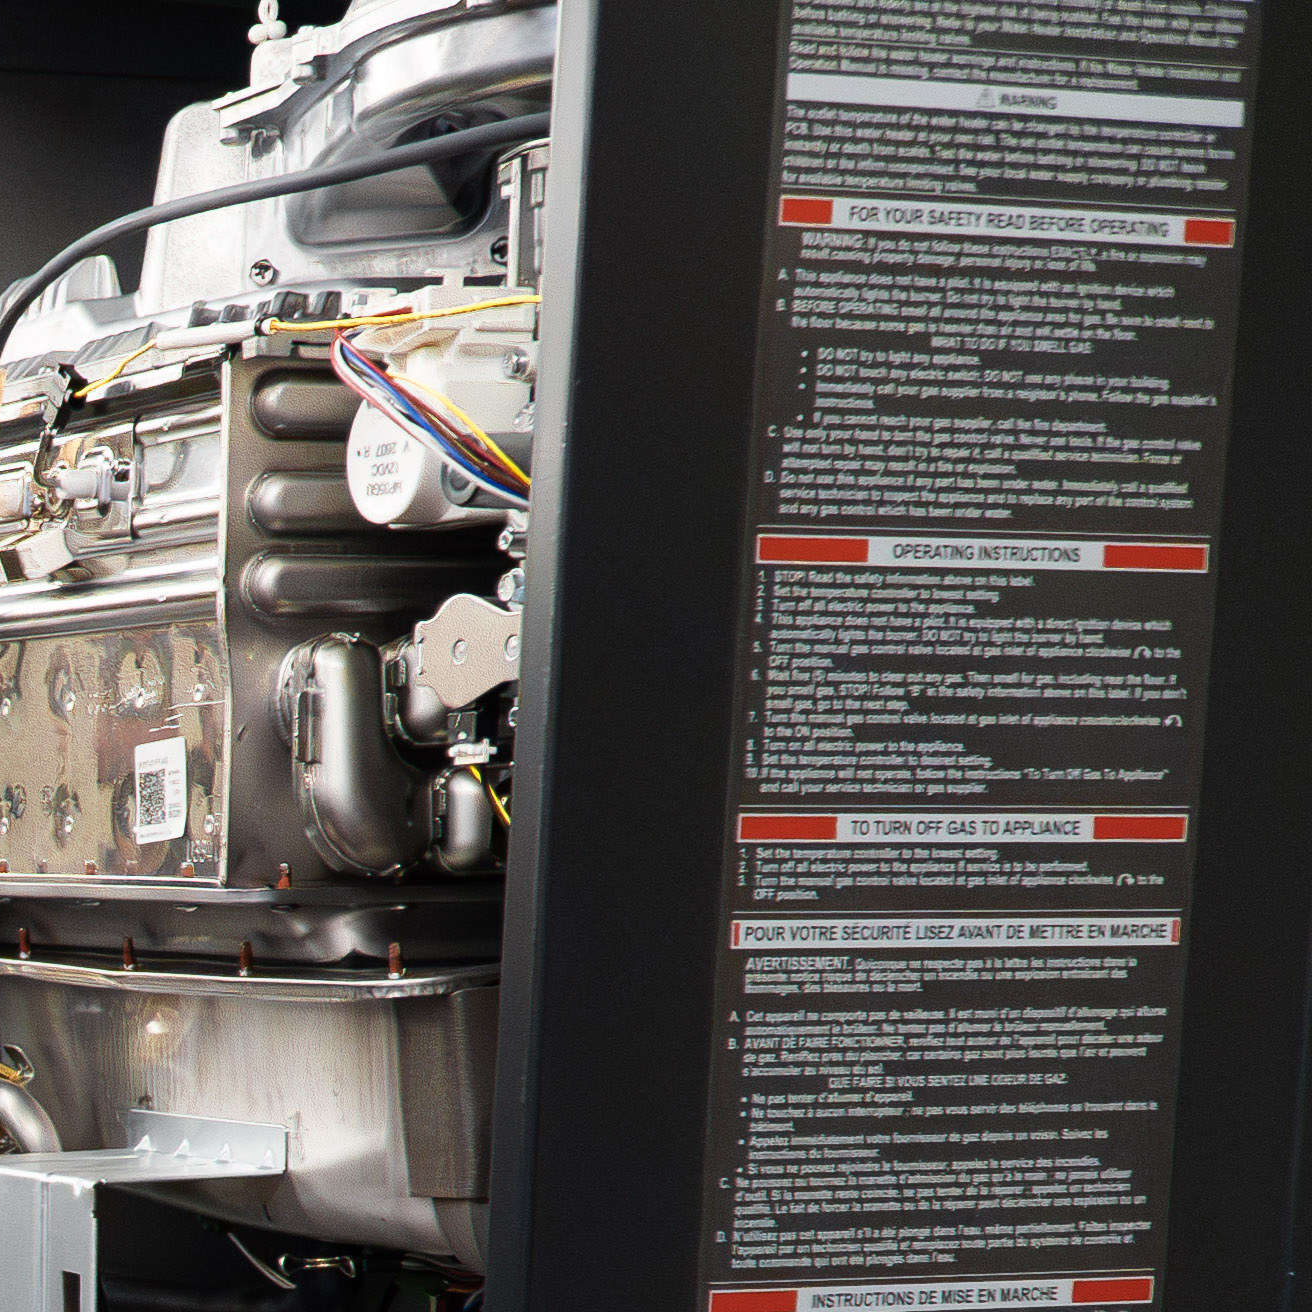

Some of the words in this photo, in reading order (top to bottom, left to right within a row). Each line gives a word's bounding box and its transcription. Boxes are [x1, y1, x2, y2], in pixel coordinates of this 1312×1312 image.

[848, 205, 879, 223] FOR
[883, 207, 923, 225] YOUR
[927, 209, 981, 228] SAFETY
[985, 212, 1025, 230] READ
[1028, 214, 1085, 232] BEFORE
[1089, 217, 1170, 237] OPERATING
[892, 543, 974, 559] OPERATING
[978, 545, 1081, 562] INSTRUCTIONS
[850, 820, 870, 835] TO
[873, 820, 912, 835] TURN
[916, 820, 942, 835] OFF
[947, 820, 977, 835] GAS
[981, 820, 999, 835] TO
[1002, 820, 1081, 835] APPLIANCE
[752, 889, 772, 899] OFF
[744, 926, 785, 941] POUR
[789, 925, 836, 940] VOTRE
[841, 922, 910, 940] SÉCURITÉ
[915, 924, 954, 939] LISEZ
[958, 924, 1002, 939] AVANT
[1005, 924, 1024, 939] DE
[1028, 924, 1082, 938] METTRE
[1087, 923, 1106, 938] EN
[1109, 923, 1167, 938] MARCHE
[812, 1291, 914, 1308] INSTRUCTIONS
[918, 1290, 937, 1304] DE
[940, 1289, 972, 1304] MISE
[977, 1288, 996, 1302] EN
[1000, 1286, 1058, 1302] MARCHE
